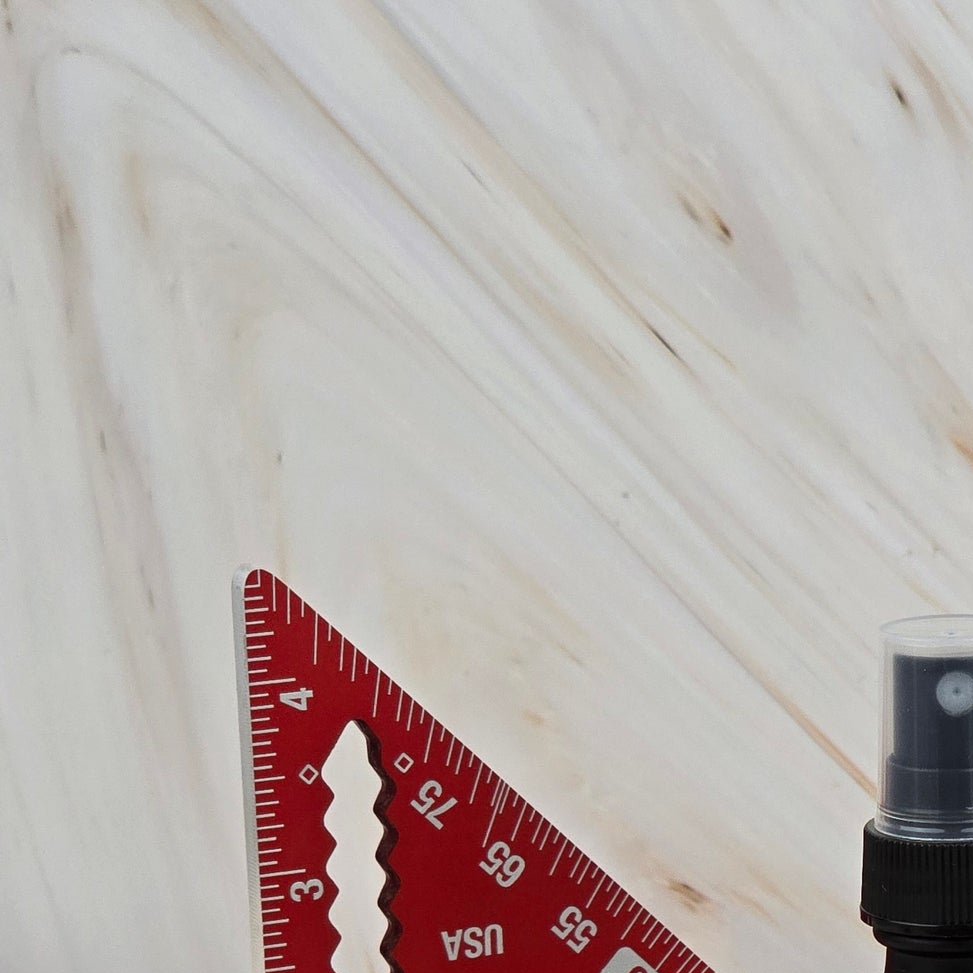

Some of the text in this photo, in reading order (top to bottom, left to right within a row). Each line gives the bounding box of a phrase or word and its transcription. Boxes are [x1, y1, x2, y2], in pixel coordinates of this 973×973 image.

[280, 688, 314, 711] 4
[411, 779, 458, 830] 75
[479, 841, 526, 888] 65
[289, 879, 324, 903] 3
[441, 924, 504, 961] USA
[551, 906, 598, 954] 55
